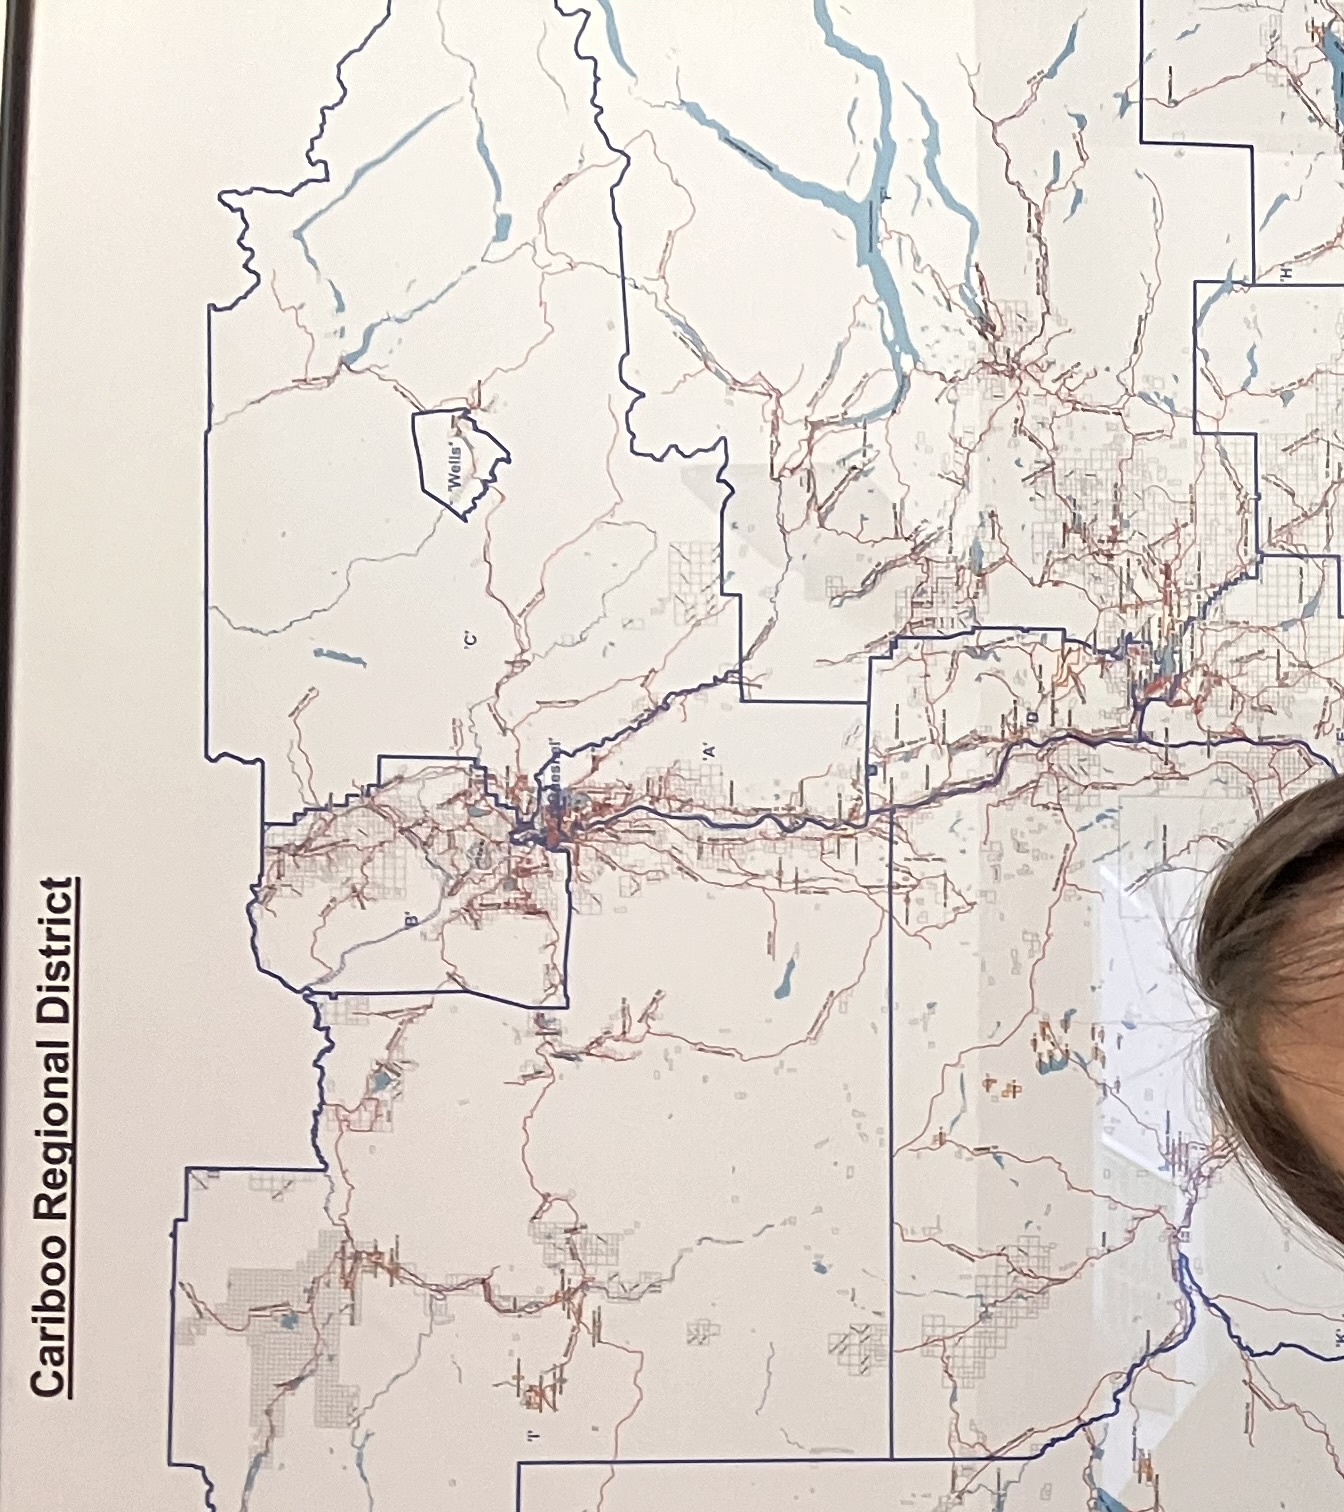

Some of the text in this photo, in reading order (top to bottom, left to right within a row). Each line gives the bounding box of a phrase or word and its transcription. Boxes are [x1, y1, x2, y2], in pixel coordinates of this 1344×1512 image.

[447, 441, 461, 492] 'Wells'
[702, 742, 716, 761] 'A'
[30, 876, 72, 1398] Cariboo Regional District
